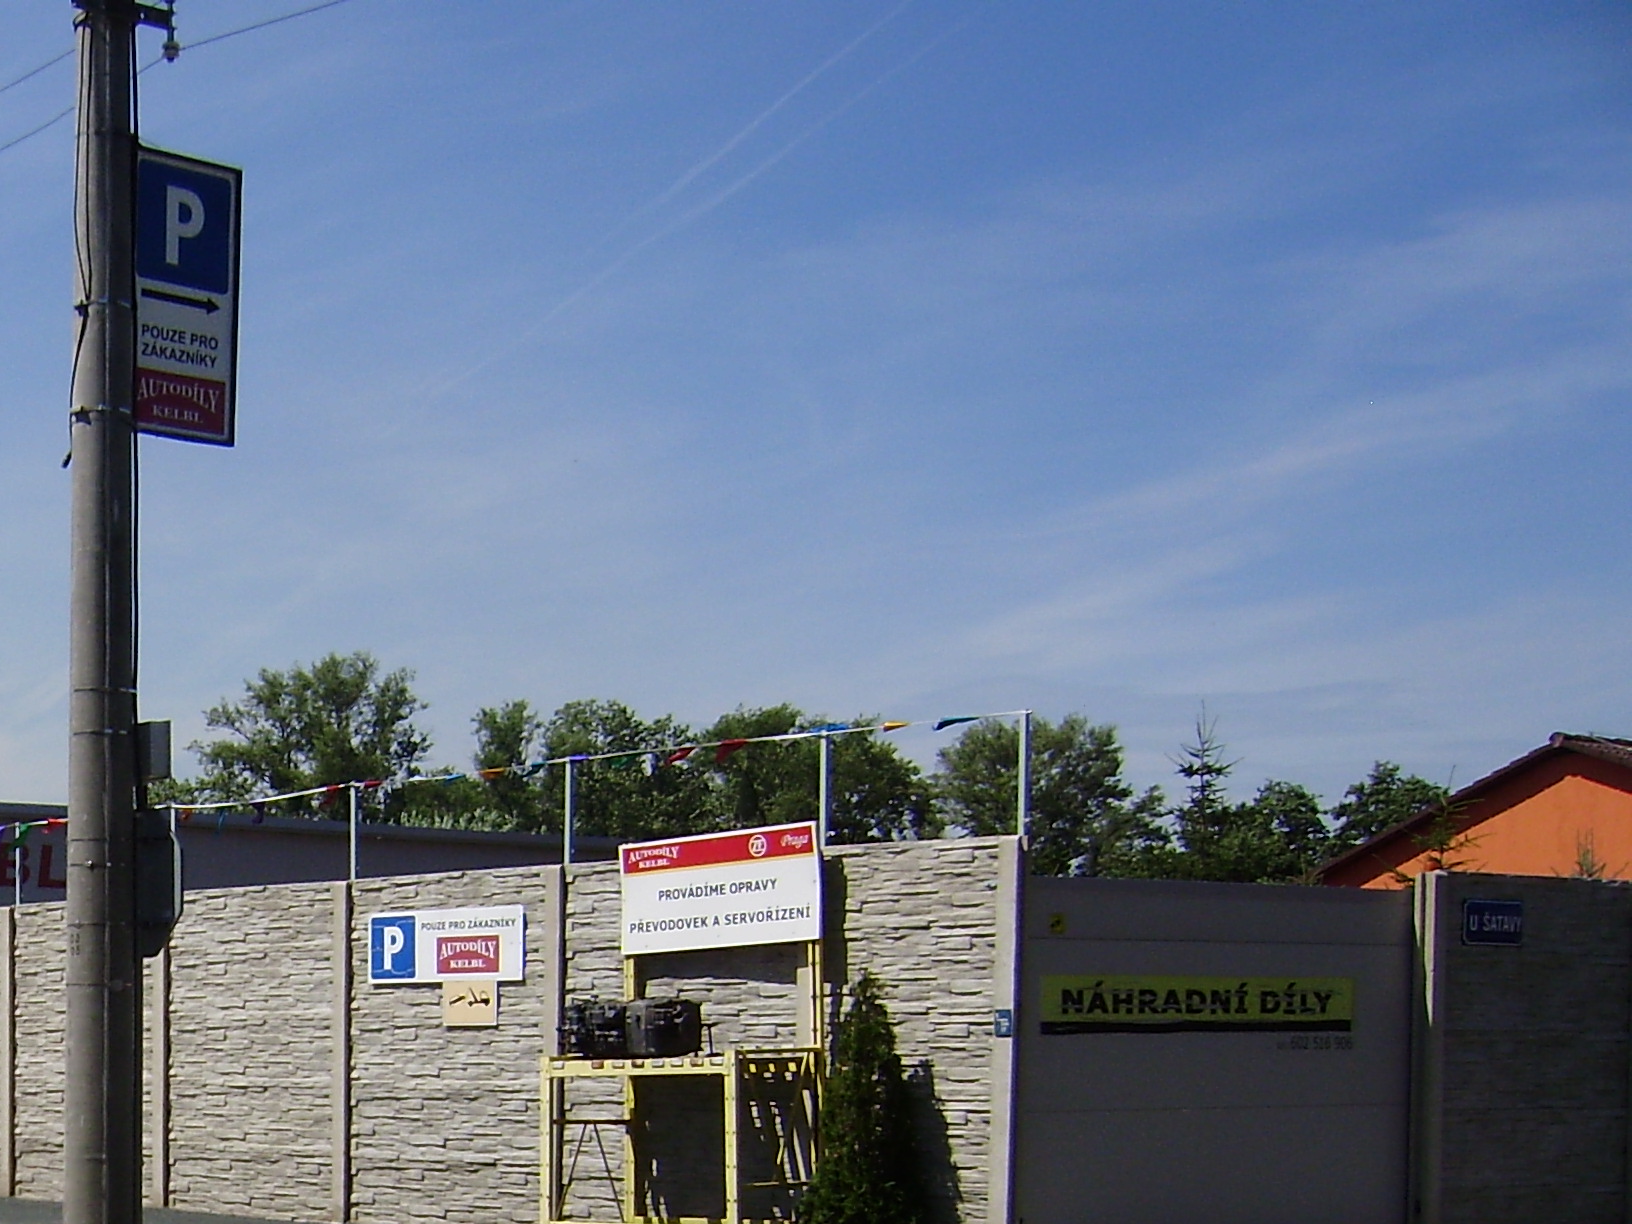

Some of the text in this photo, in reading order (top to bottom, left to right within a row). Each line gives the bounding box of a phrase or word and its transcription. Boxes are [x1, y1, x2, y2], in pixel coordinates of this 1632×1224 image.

[165, 185, 205, 266] P
[141, 323, 219, 350] POUZE PRO
[141, 340, 218, 368] ZÁKAZNÍKY
[136, 377, 220, 414] AUTODÍLY
[152, 404, 204, 424] KELBL
[779, 833, 809, 849] Praga
[628, 846, 680, 864] AUTODÍLY
[639, 858, 671, 869] KELBL
[658, 878, 777, 901] PROVÁDÍME OPRAVY
[421, 917, 517, 931] POUZE PRO ZÁKAZNÍKY
[629, 903, 811, 933] PŘEVODOVEK A SERVOŘÍZENÍ
[1469, 911, 1521, 932] U ŠATAVY
[383, 926, 404, 970] P
[439, 940, 497, 960] AUTODÍLY
[449, 958, 486, 969] KELBL
[1060, 980, 1332, 1014] NÁHRADNÍ DÍLY
